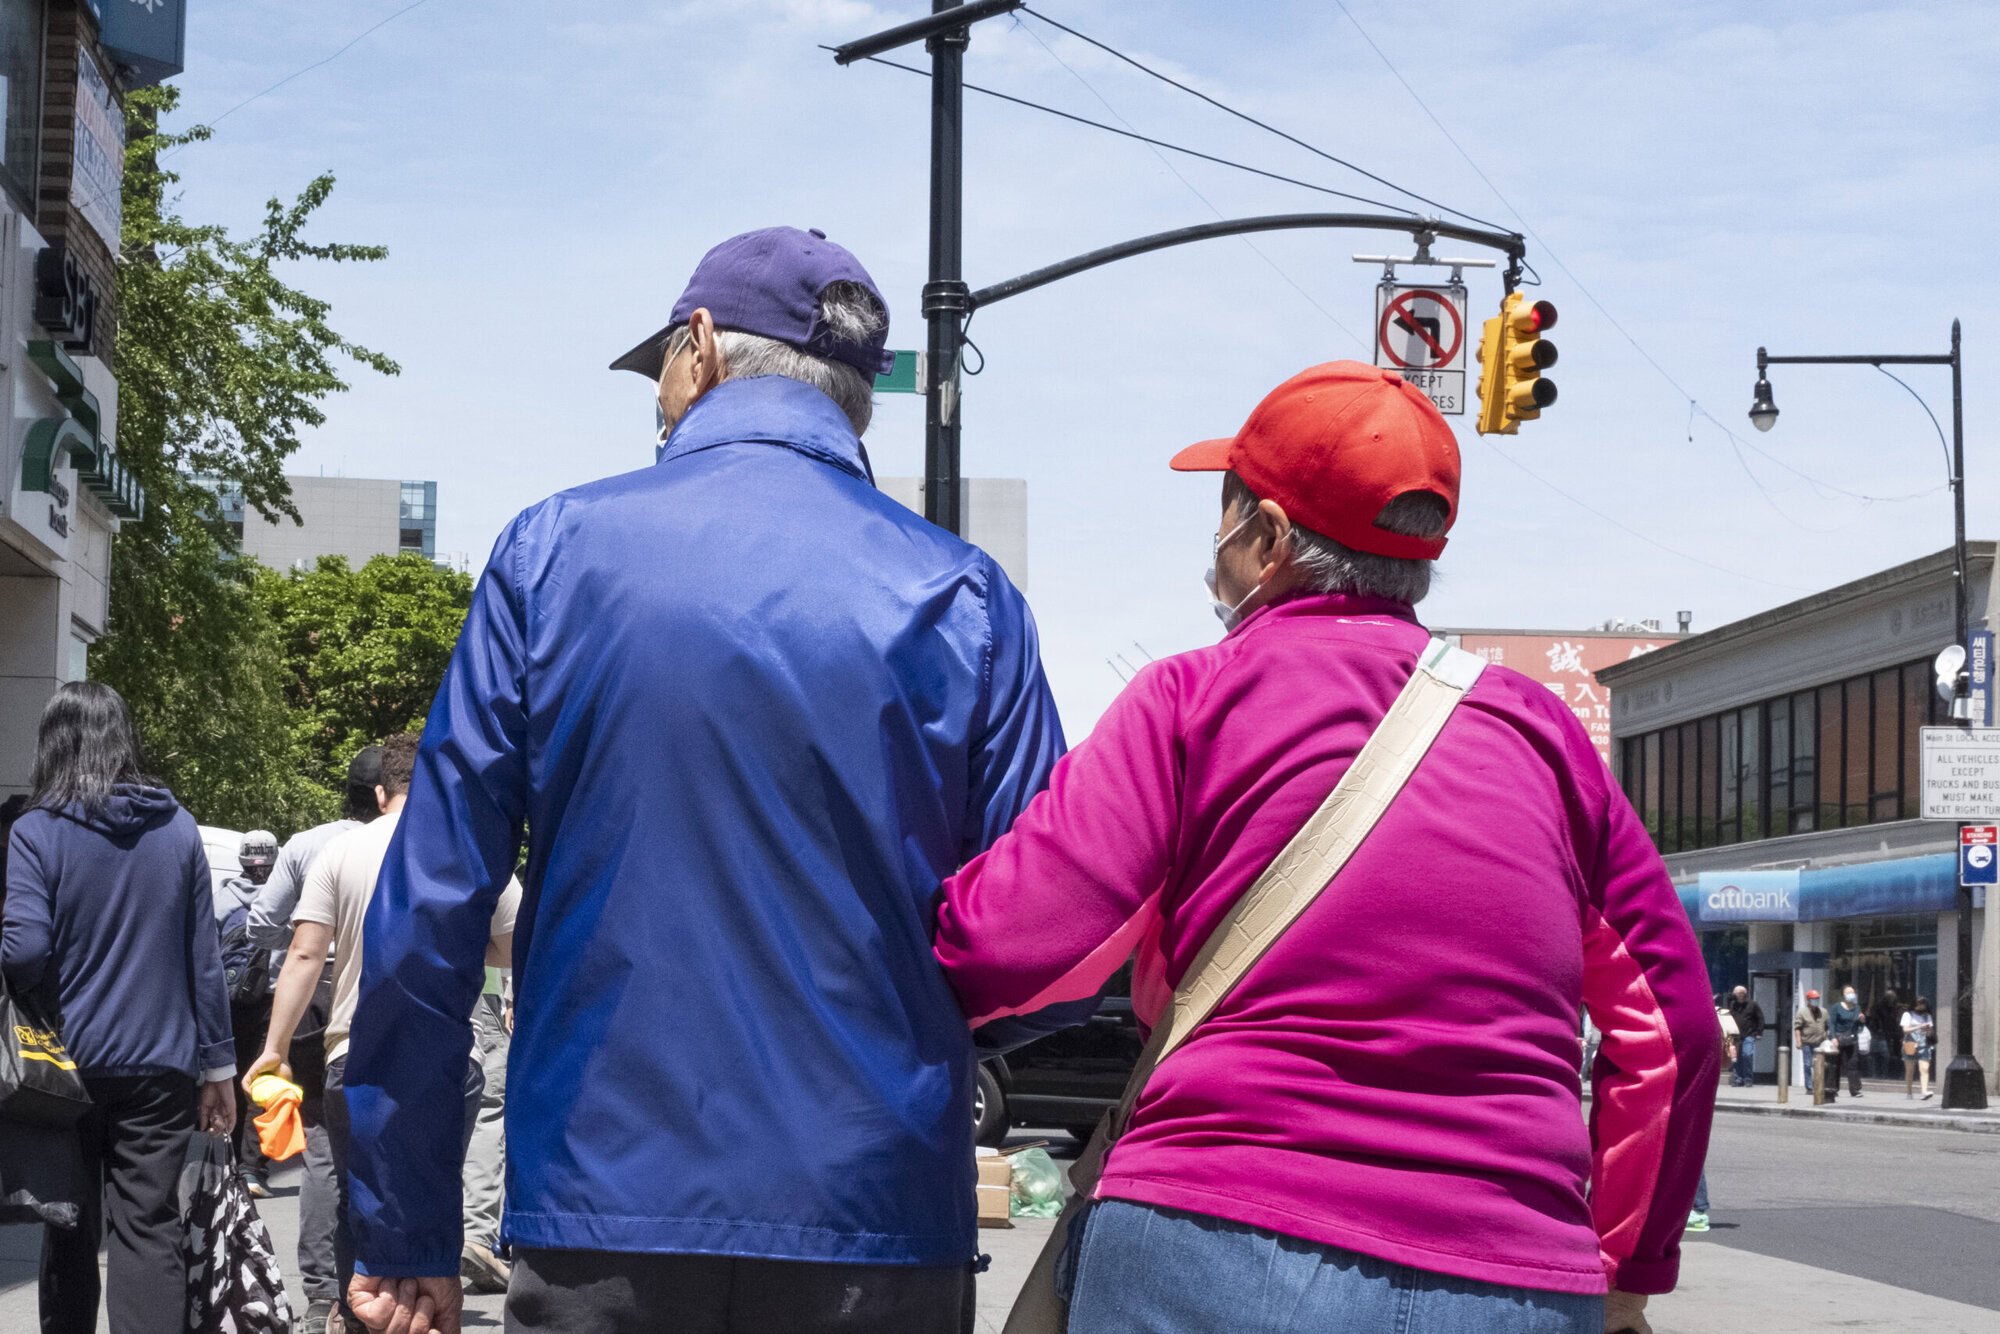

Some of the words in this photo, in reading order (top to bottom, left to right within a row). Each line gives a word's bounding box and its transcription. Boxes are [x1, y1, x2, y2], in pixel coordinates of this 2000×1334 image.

[1401, 375, 1443, 388] XCEPT
[1429, 395, 1455, 409] SES
[1569, 705, 1590, 719] on
[1956, 734, 1979, 742] LOCAL
[1937, 755, 1953, 764] ALL
[1957, 755, 1999, 764] VEHICLES
[1952, 767, 1985, 777] EXCEPT
[1927, 780, 1959, 789] TRUCKS
[1962, 780, 1980, 789] AND
[1942, 793, 1965, 802] MUST
[1970, 793, 1994, 802] MAKE
[1930, 805, 1951, 815] NEXT
[1955, 805, 1980, 815] RIGHT
[1707, 887, 1791, 909] citibank
